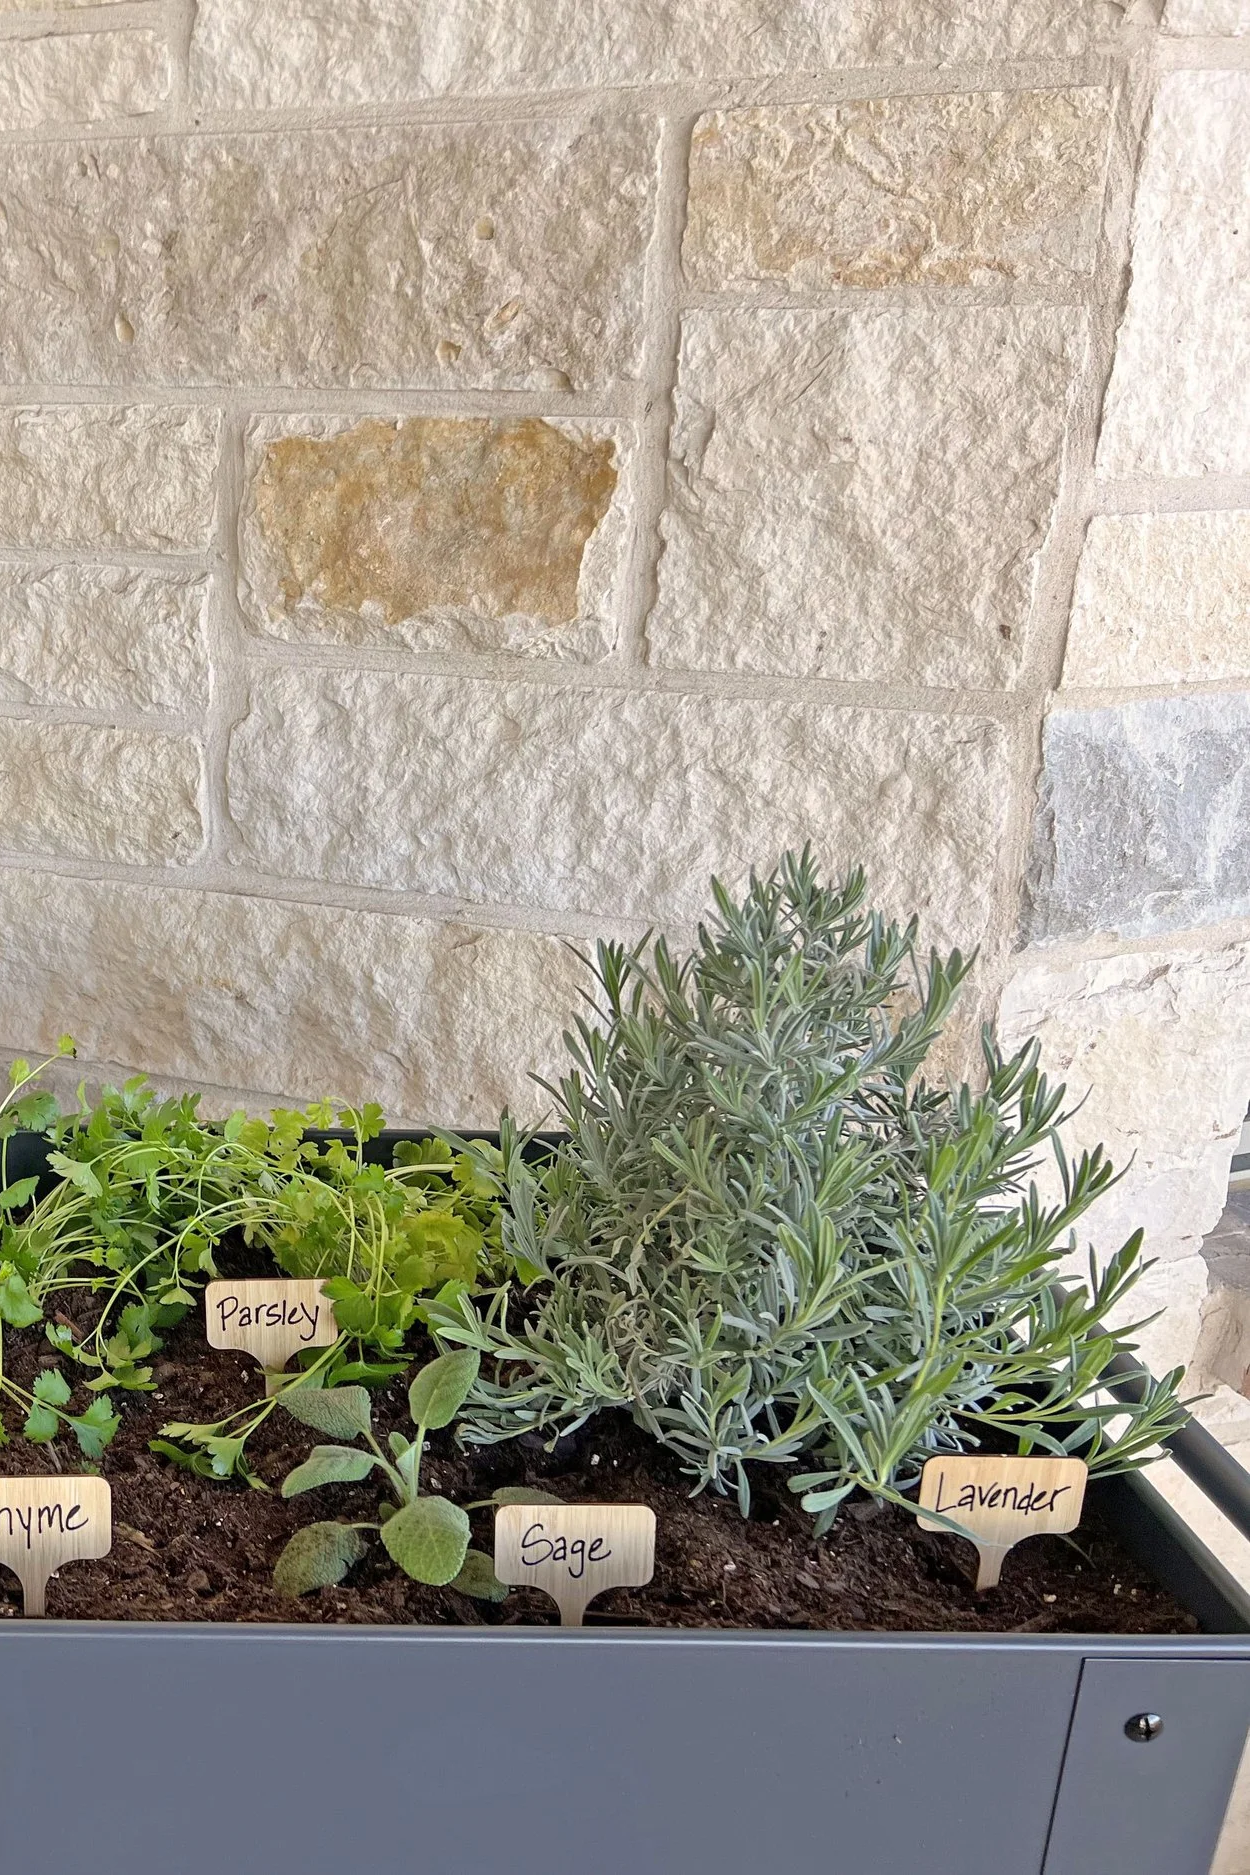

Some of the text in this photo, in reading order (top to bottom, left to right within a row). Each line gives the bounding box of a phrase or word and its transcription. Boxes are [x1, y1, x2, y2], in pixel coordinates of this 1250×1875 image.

[216, 1296, 320, 1342] Parsley
[934, 1472, 1072, 1515] Lavender
[520, 1522, 612, 1579] Sage
